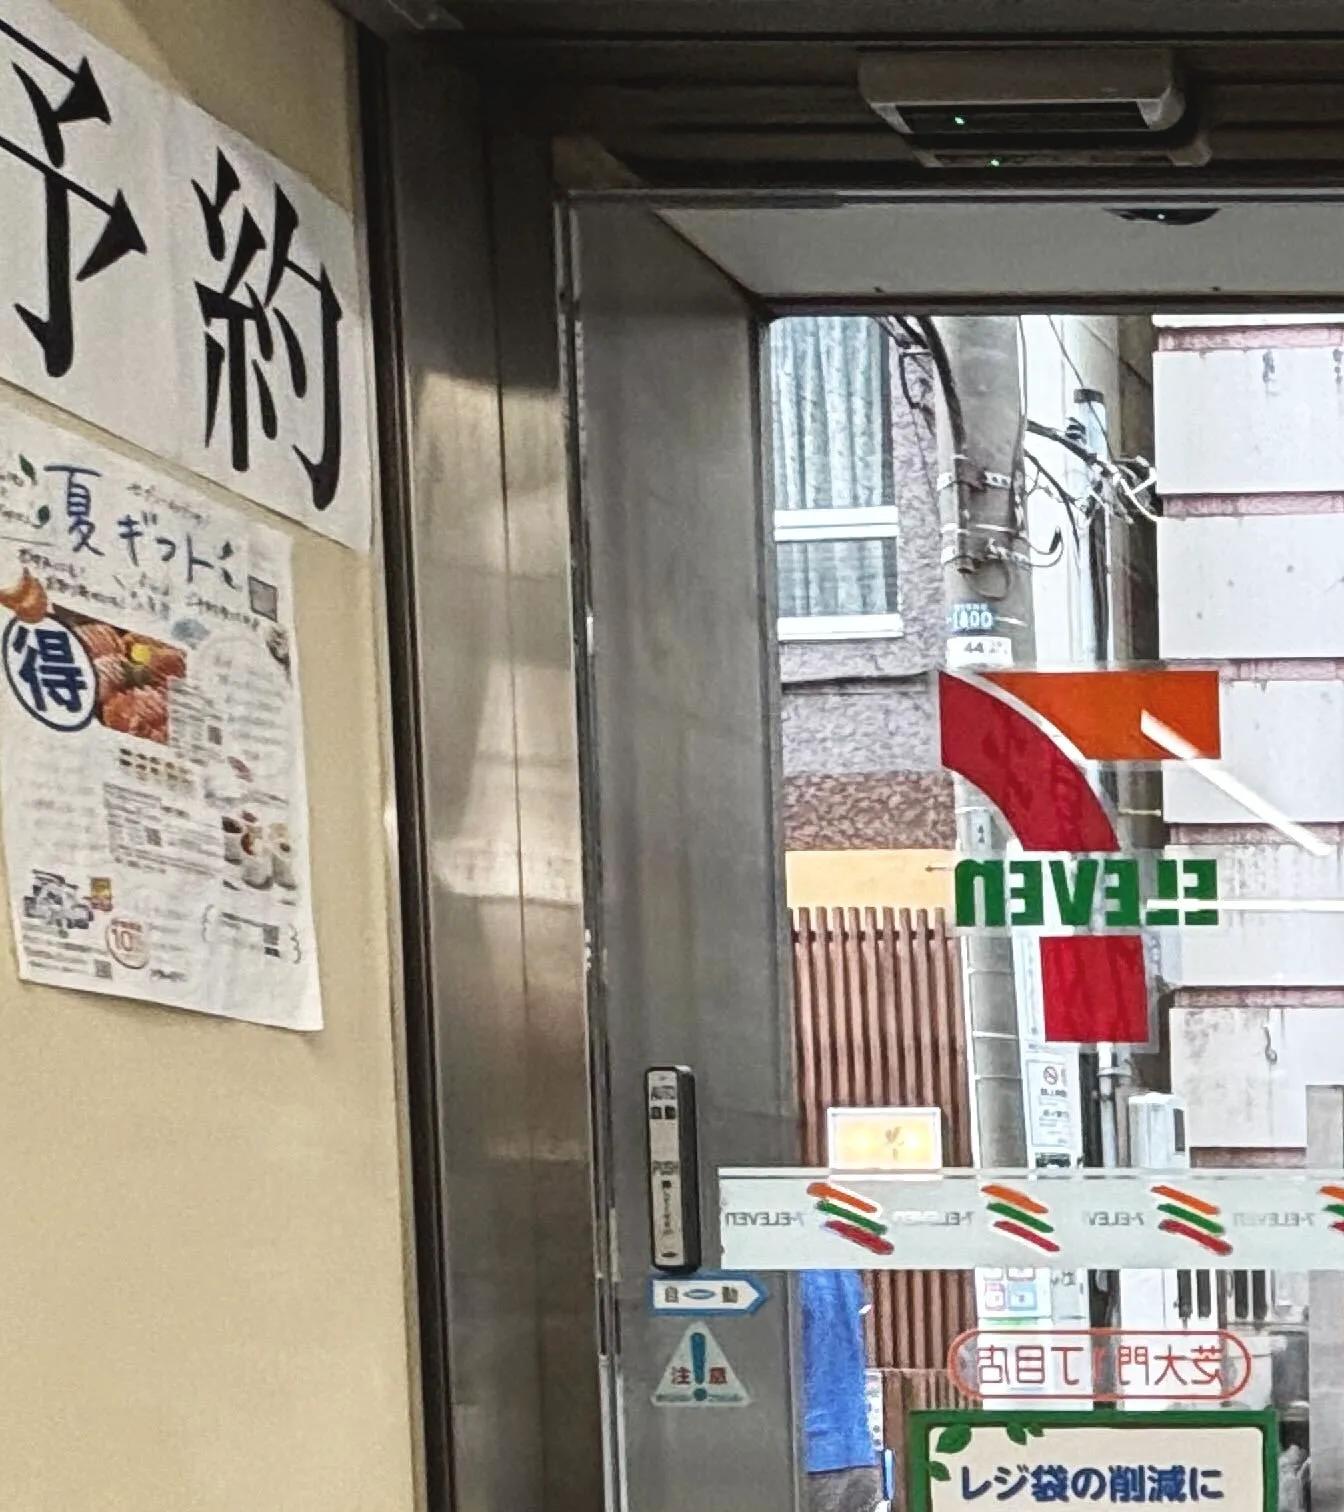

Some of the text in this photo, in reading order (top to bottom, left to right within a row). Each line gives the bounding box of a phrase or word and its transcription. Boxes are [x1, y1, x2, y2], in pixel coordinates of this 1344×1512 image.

[0, 18, 344, 512] 予約
[12, 626, 89, 712] 得
[961, 1464, 1225, 1503] レジ袋の削減に
